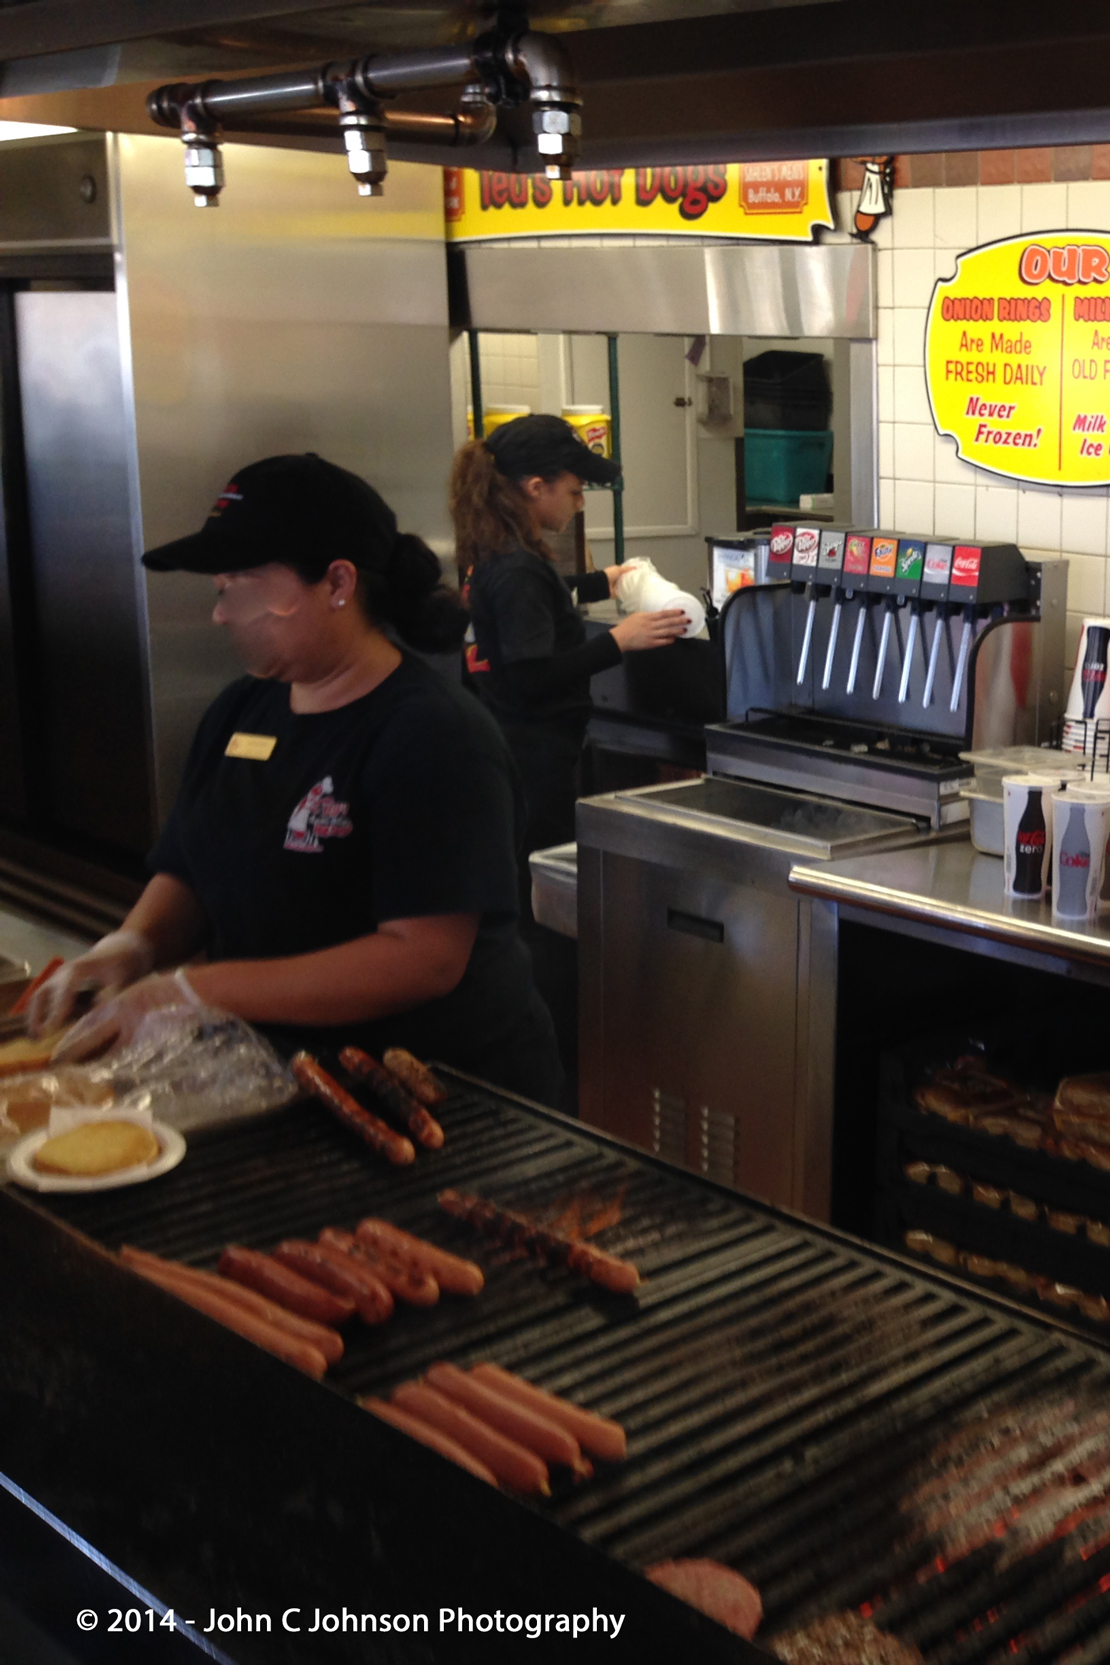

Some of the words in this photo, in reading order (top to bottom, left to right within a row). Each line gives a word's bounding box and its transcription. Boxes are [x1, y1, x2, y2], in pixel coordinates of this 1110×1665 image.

[748, 187, 782, 203] Buffalo,
[1018, 244, 1110, 287] OUR
[942, 296, 994, 322] ONION
[997, 297, 1051, 322] RINGS
[959, 330, 984, 352] Are
[990, 331, 1032, 355] Made
[945, 360, 996, 383] FRESH
[1003, 362, 1046, 386] DAILY
[1072, 358, 1098, 380] OLD
[965, 396, 1016, 419] Never
[1072, 413, 1107, 433] Milk
[974, 423, 1042, 448] Frozen!
[1080, 438, 1103, 456] Ice
